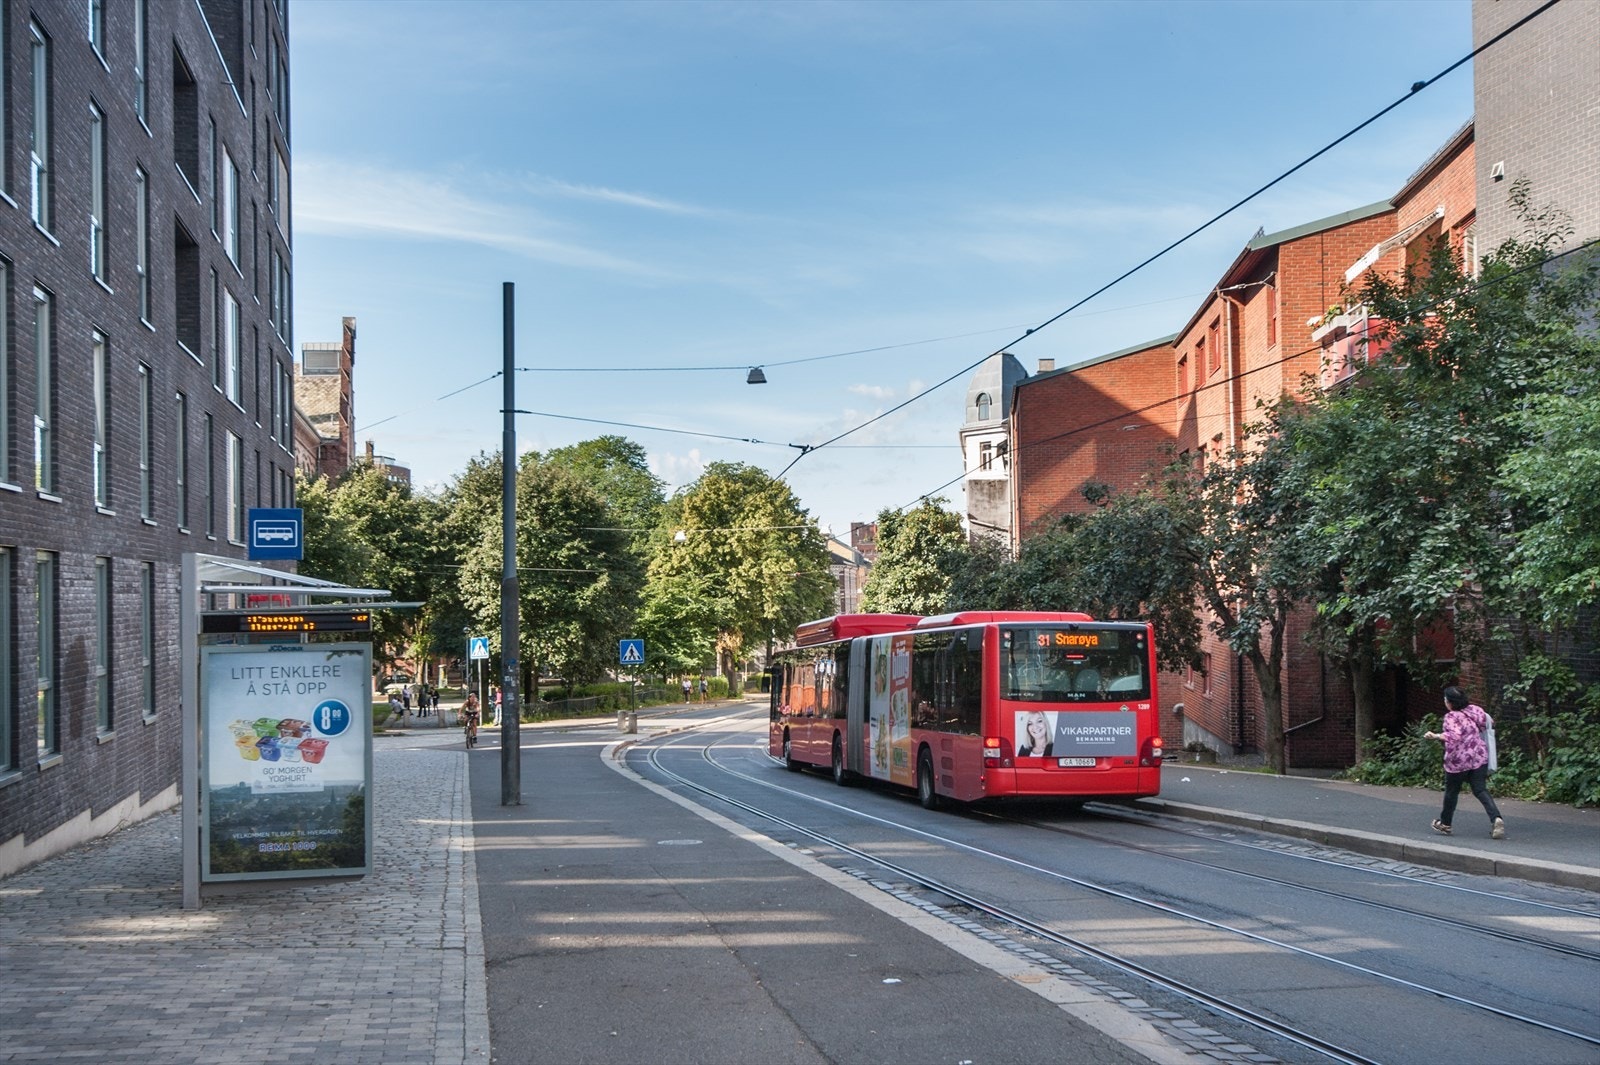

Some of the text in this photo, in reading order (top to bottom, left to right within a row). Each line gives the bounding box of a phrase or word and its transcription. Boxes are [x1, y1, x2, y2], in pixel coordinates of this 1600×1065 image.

[1038, 632, 1098, 647] 31 Snarøya
[231, 664, 342, 680] LITT ENKLERE
[246, 680, 327, 696] Å STÅ OPP
[321, 706, 331, 730] 8
[1060, 726, 1132, 736] VIKARPARTNER
[262, 766, 313, 775] GO' MORGEN
[268, 774, 307, 783] YOGHURT
[232, 831, 271, 840] VELKOMMEN
[271, 830, 296, 838] TILBAKE
[307, 828, 344, 836] HVERDAGEN
[259, 841, 318, 853] REMA 1000
